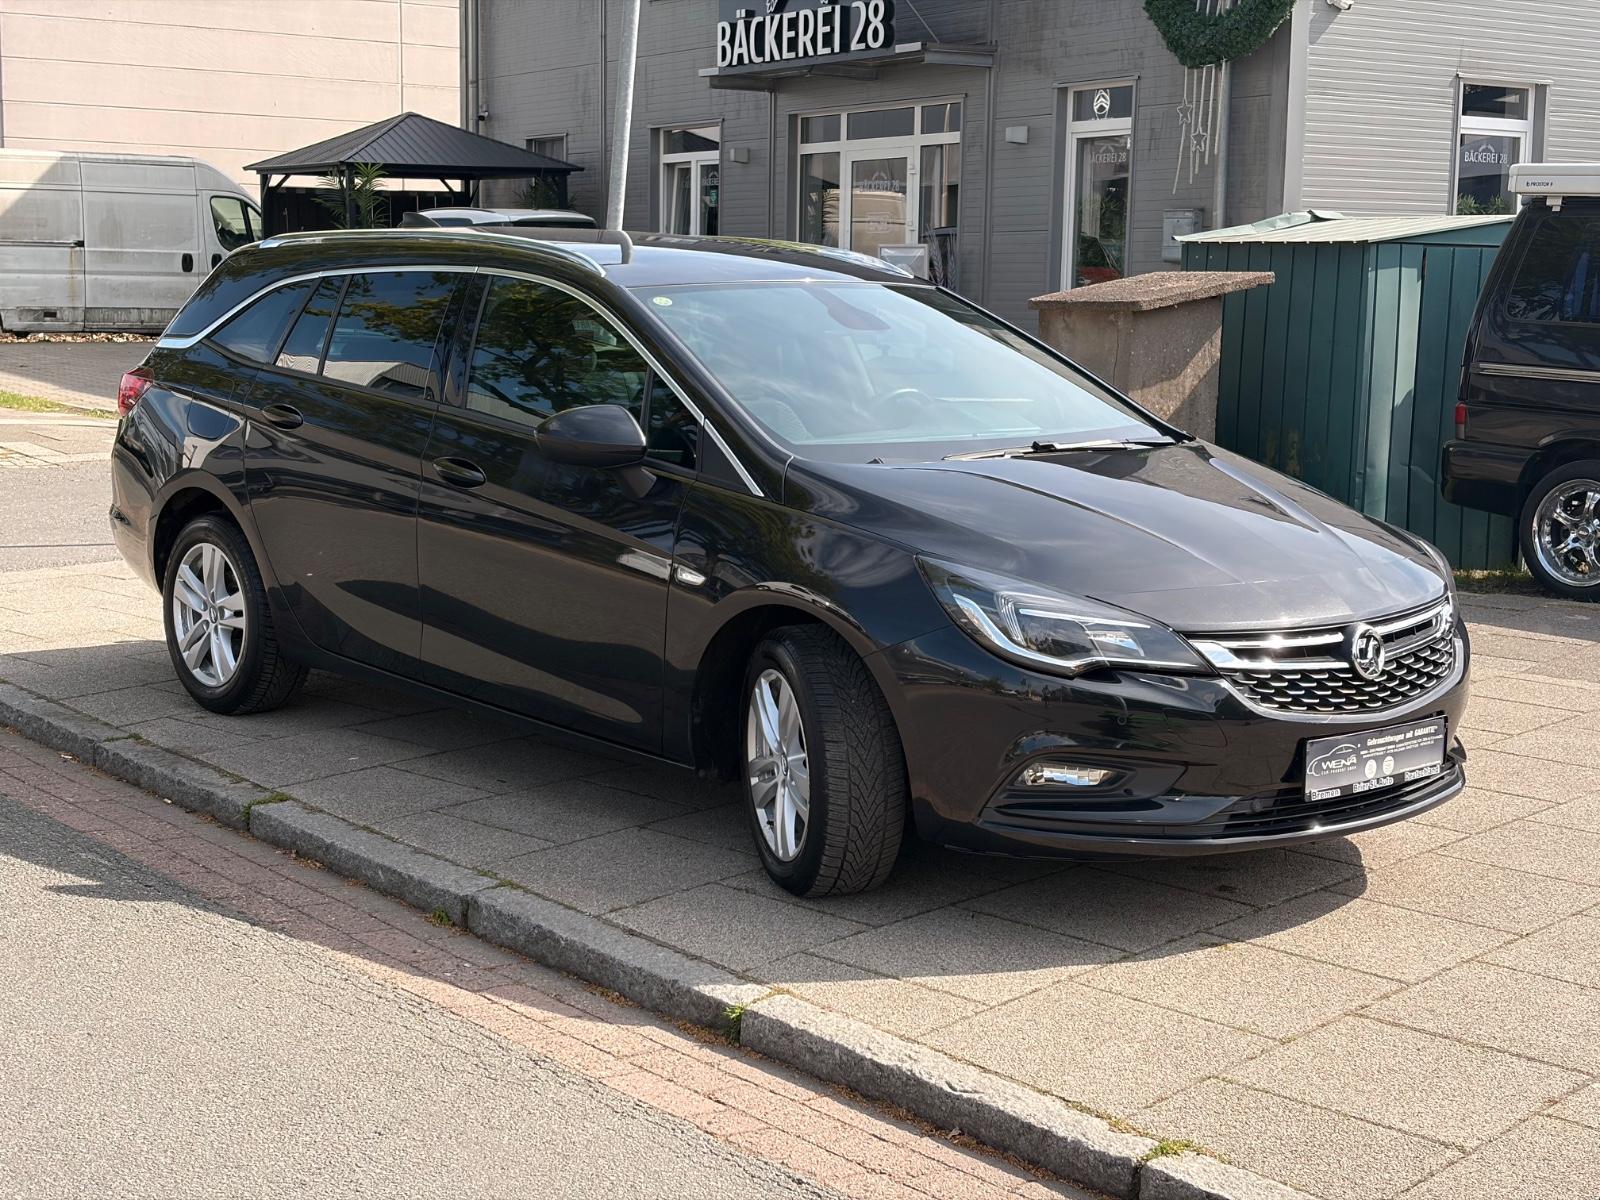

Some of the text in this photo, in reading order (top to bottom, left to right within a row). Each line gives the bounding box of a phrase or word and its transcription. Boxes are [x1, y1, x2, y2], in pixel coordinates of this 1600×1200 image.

[717, 0, 885, 67] BÄCKEREI 28
[1119, 152, 1127, 162] 28
[1464, 150, 1498, 163] BÄCKEREI
[1312, 789, 1340, 801] Bremen
